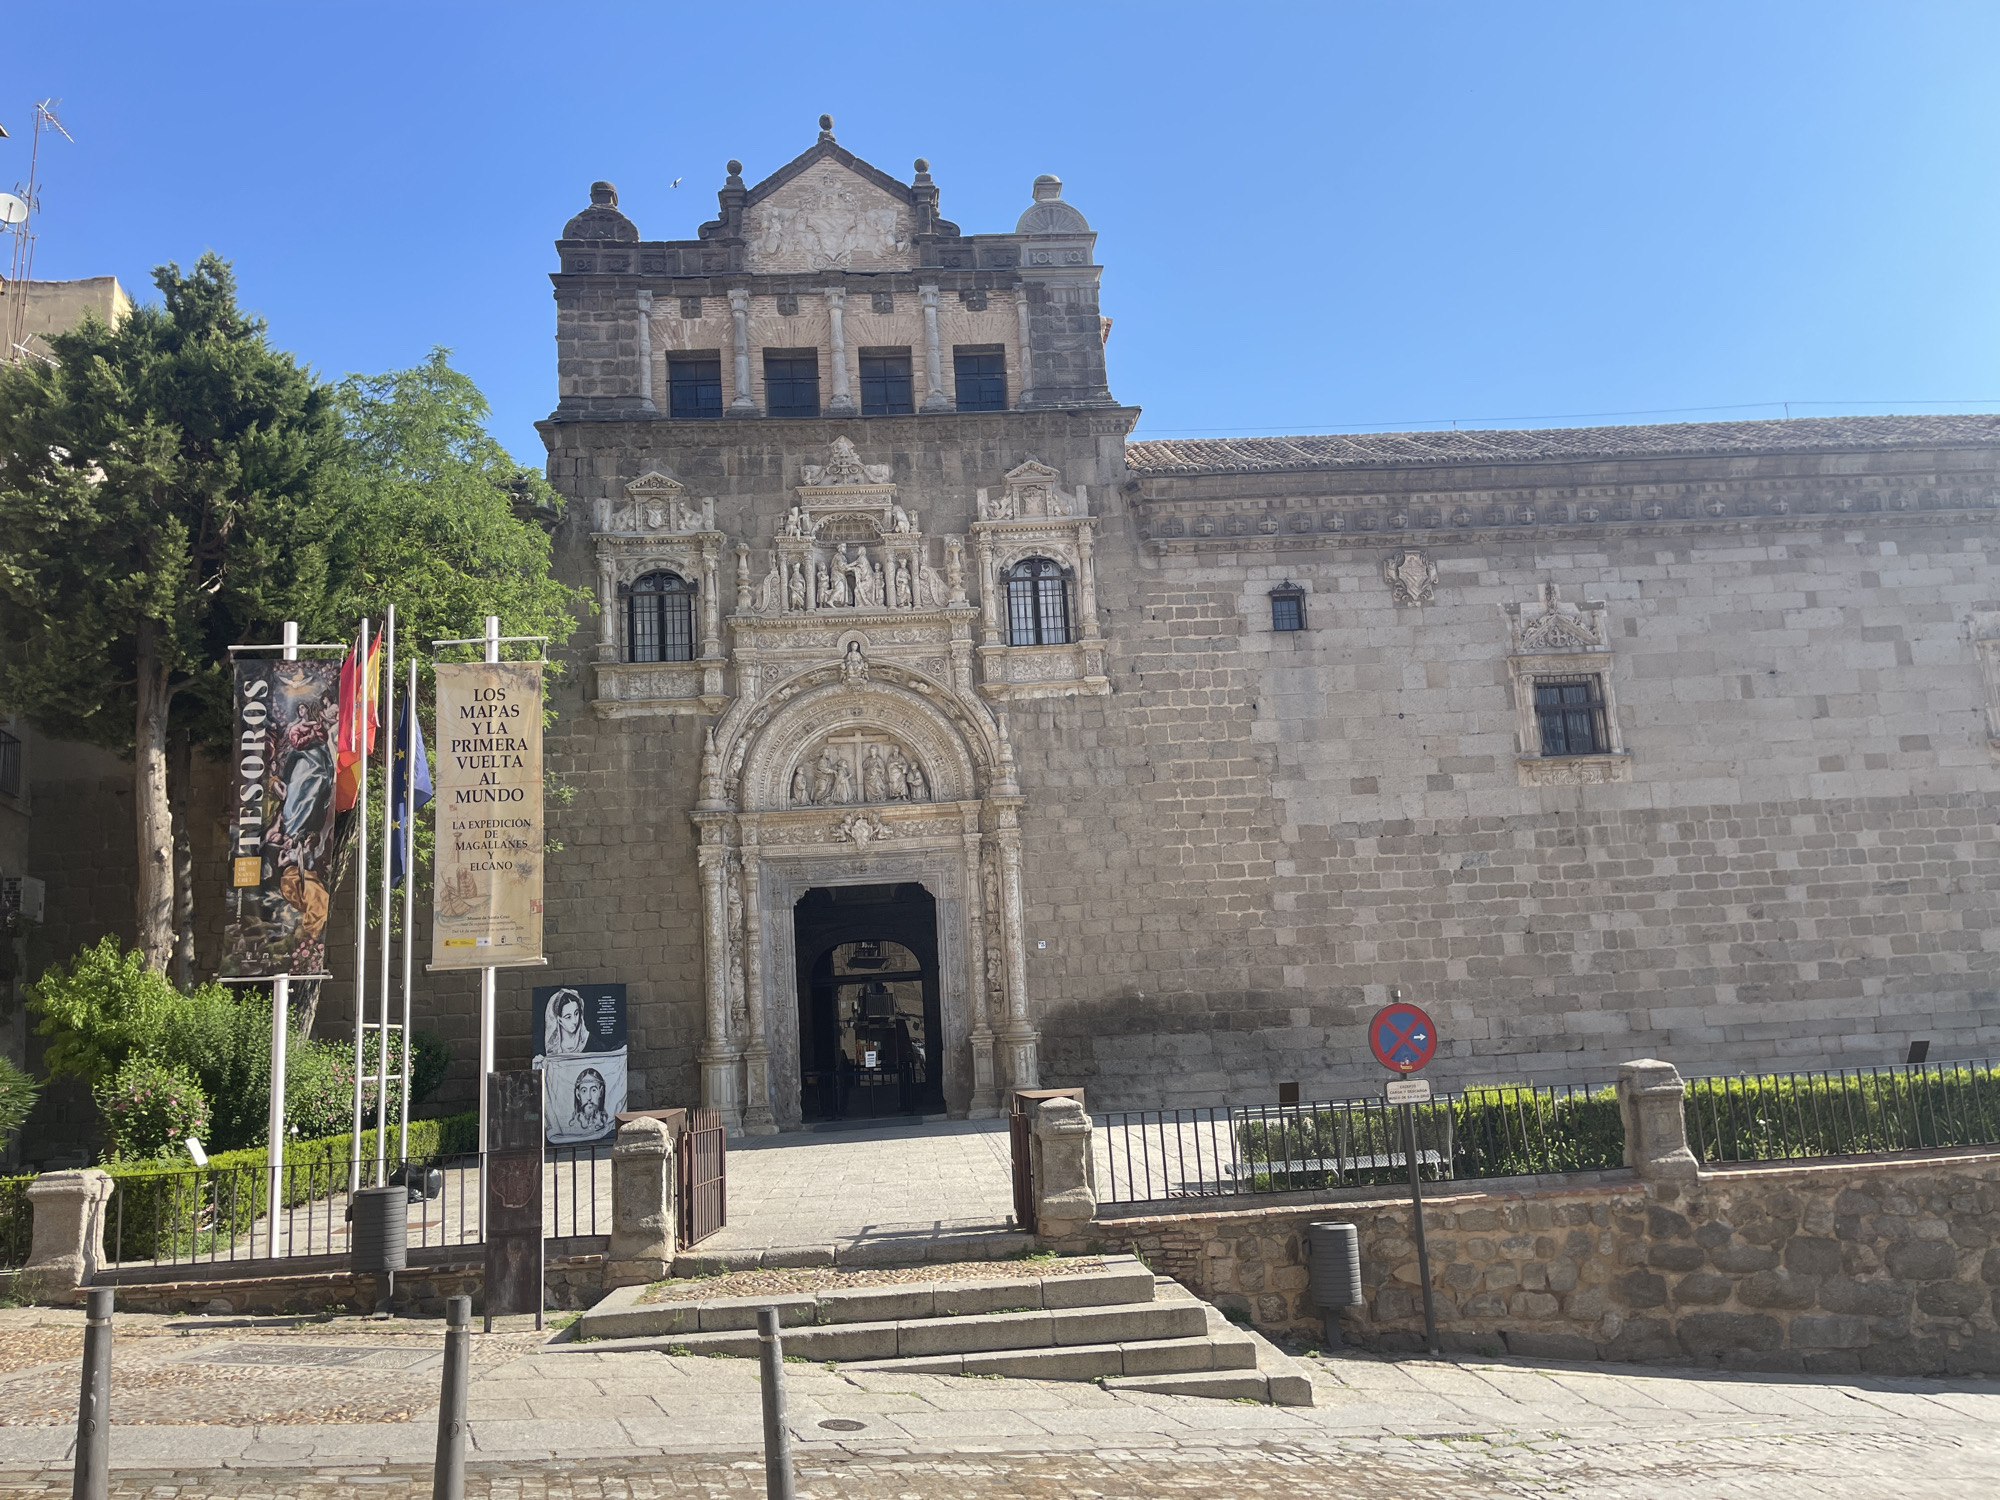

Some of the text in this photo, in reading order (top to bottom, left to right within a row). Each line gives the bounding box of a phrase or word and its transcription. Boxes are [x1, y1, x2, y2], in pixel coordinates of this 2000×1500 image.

[474, 688, 506, 702] LOS
[460, 704, 520, 719] MAPAS
[471, 721, 508, 735] Y LA
[451, 738, 528, 753] PRIMERA
[238, 680, 269, 854] TESOROS
[456, 754, 523, 769] VUELTA
[479, 772, 501, 786] AL
[455, 788, 524, 804] MUNDO
[452, 817, 531, 830] LA EXPEDICIÓN
[484, 830, 498, 839] DE
[455, 840, 528, 851] MAGALLANES
[487, 851, 494, 860] Y
[470, 861, 513, 872] ELCANO
